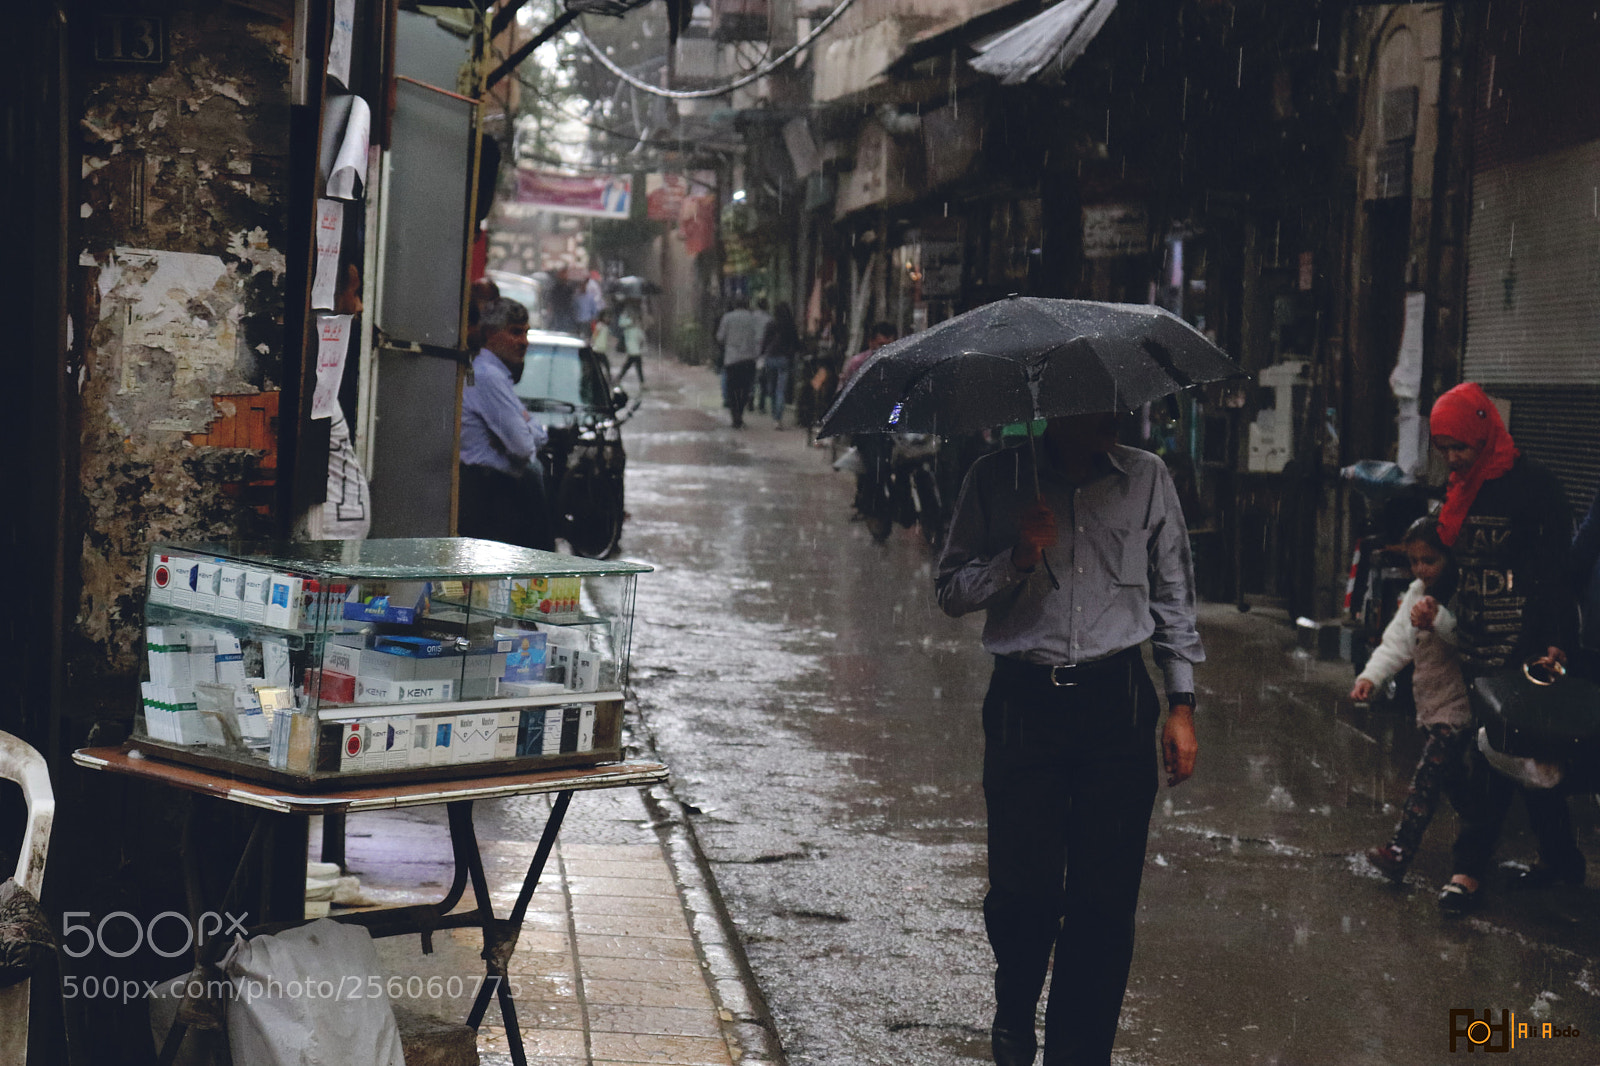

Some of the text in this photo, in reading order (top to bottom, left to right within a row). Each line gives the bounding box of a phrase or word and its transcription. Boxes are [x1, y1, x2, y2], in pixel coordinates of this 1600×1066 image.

[112, 19, 155, 59] 13
[365, 688, 387, 697] KENT
[407, 688, 434, 697] KENT
